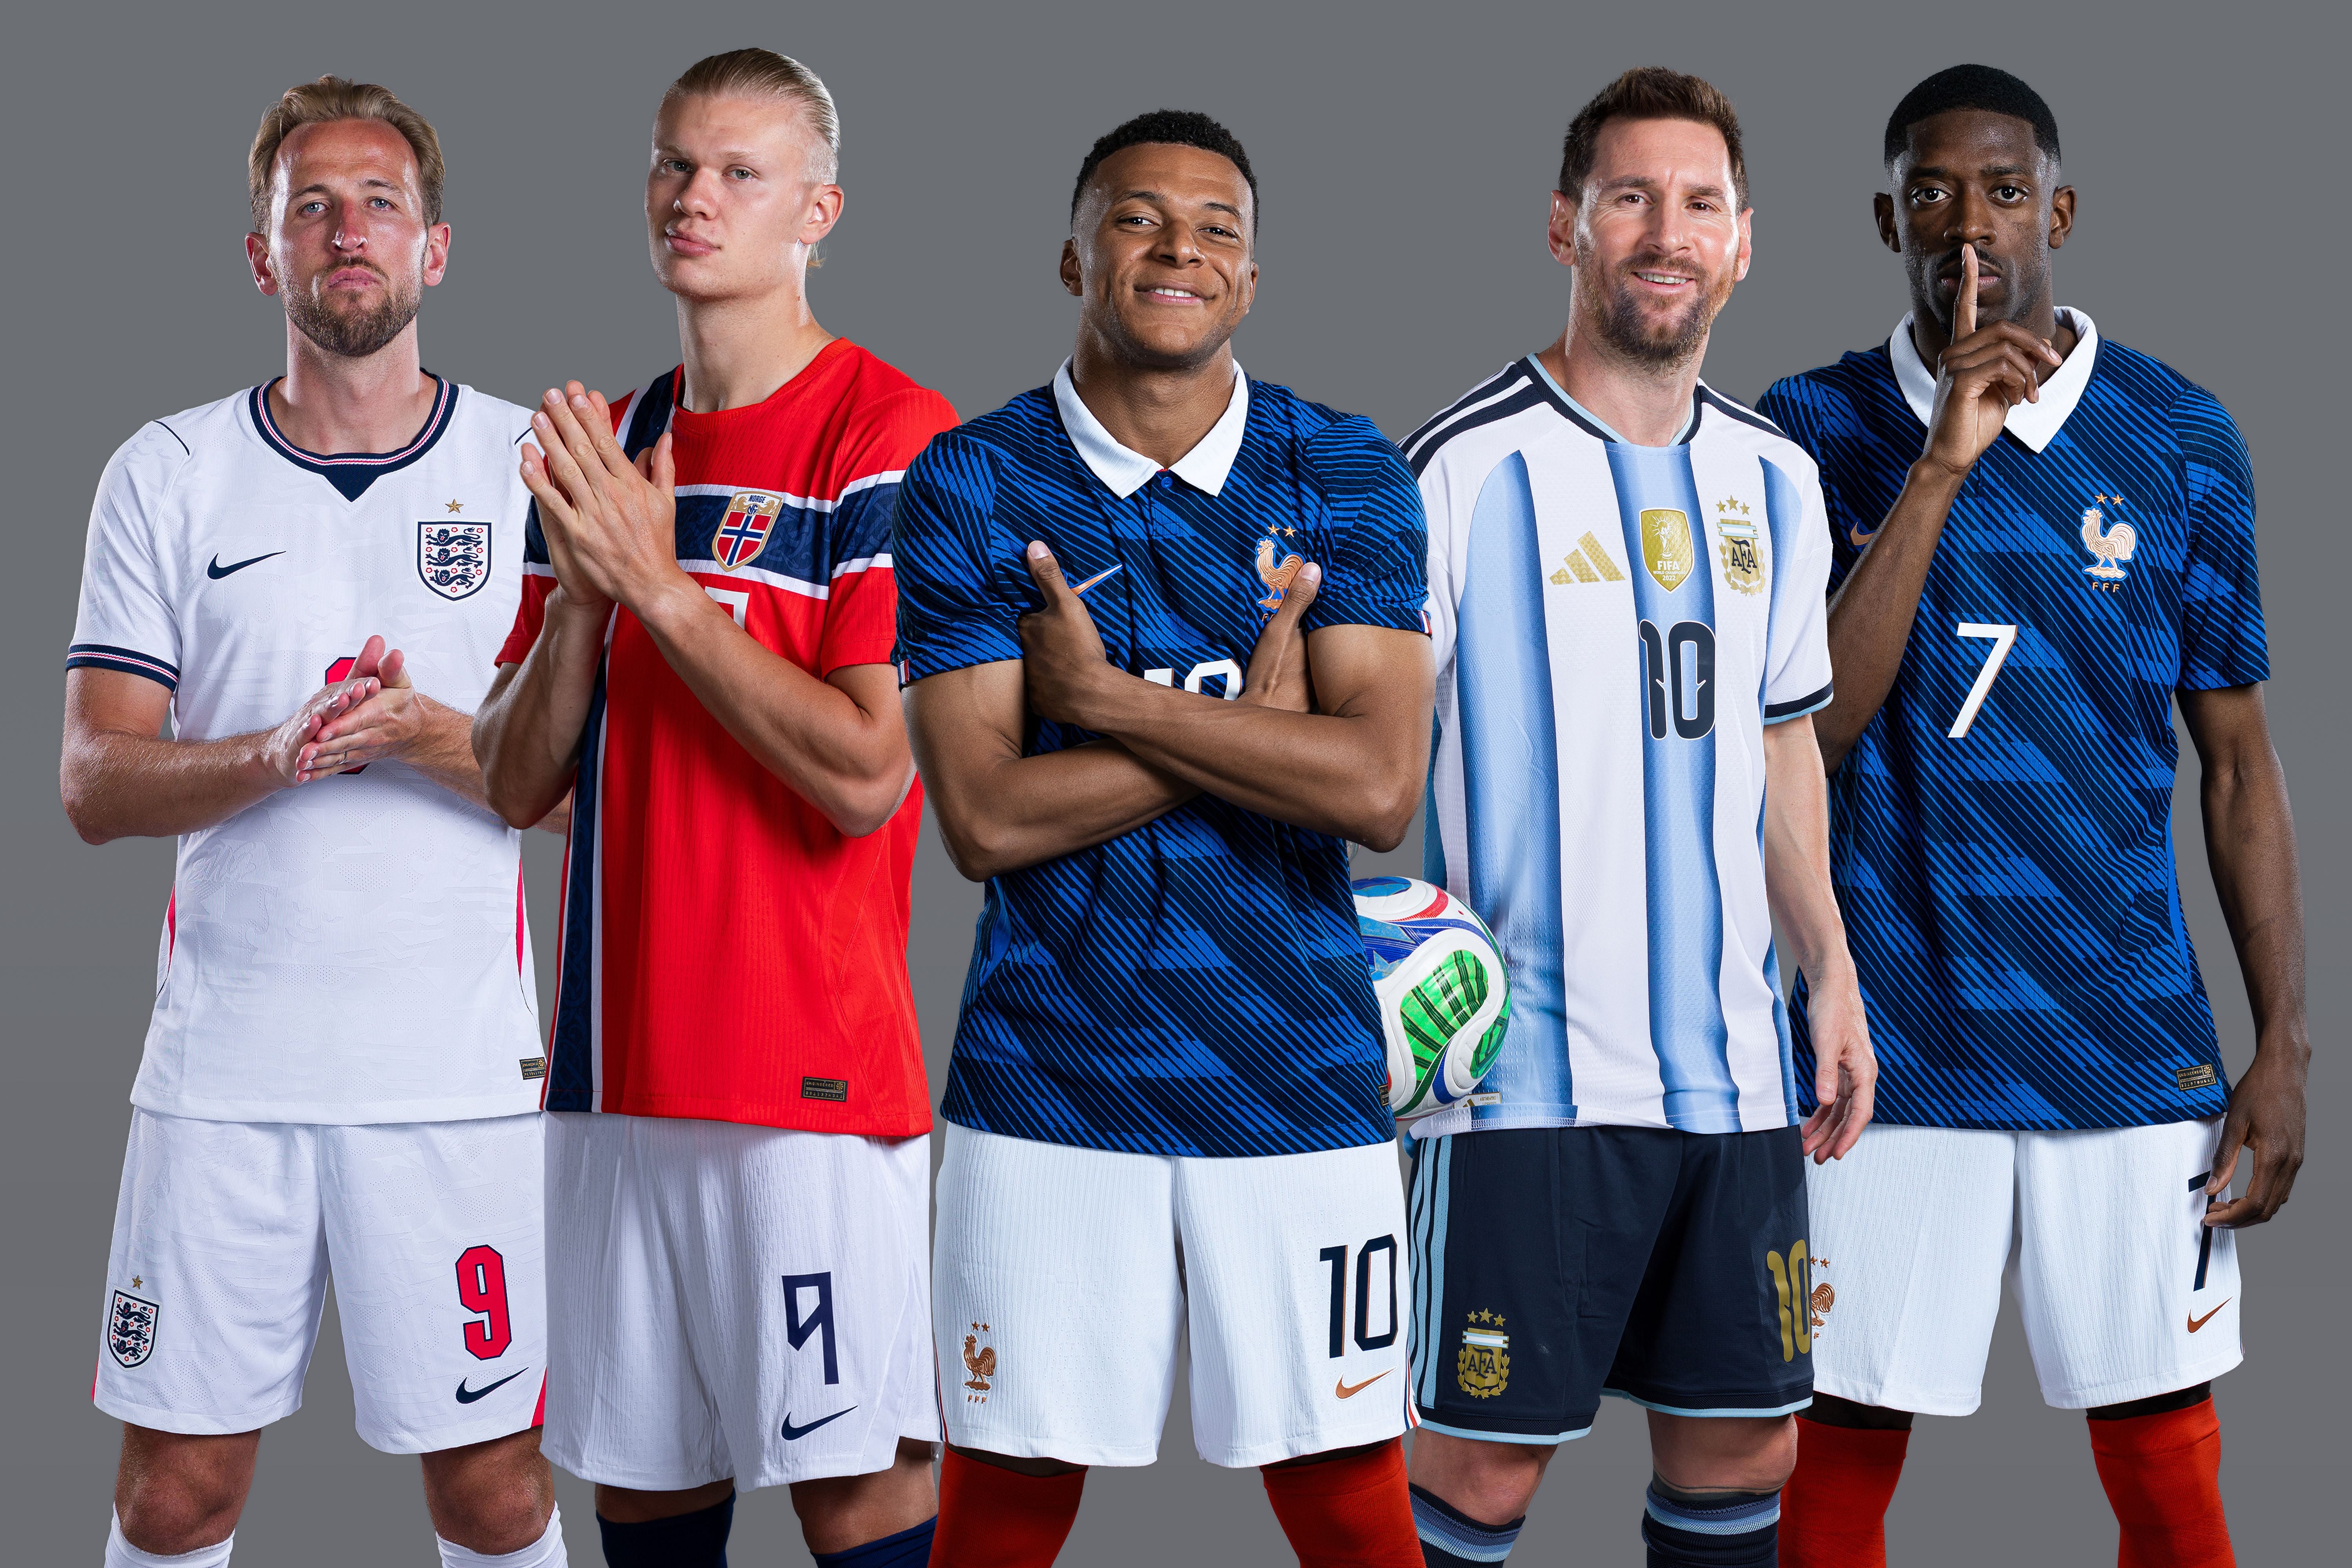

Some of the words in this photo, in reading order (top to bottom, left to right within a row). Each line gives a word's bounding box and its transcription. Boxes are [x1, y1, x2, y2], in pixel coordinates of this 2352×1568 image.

[748, 495, 766, 503] NORGE
[1731, 538, 1757, 574] AFA
[1657, 561, 1680, 570] FIFA
[1639, 619, 1716, 740] 10
[1947, 622, 2018, 738] 7
[455, 1244, 512, 1361] 9
[781, 1271, 839, 1385] 9
[1319, 1233, 1398, 1358] 10
[1767, 1239, 1811, 1362] 10
[1467, 1346, 1497, 1379] AFA
